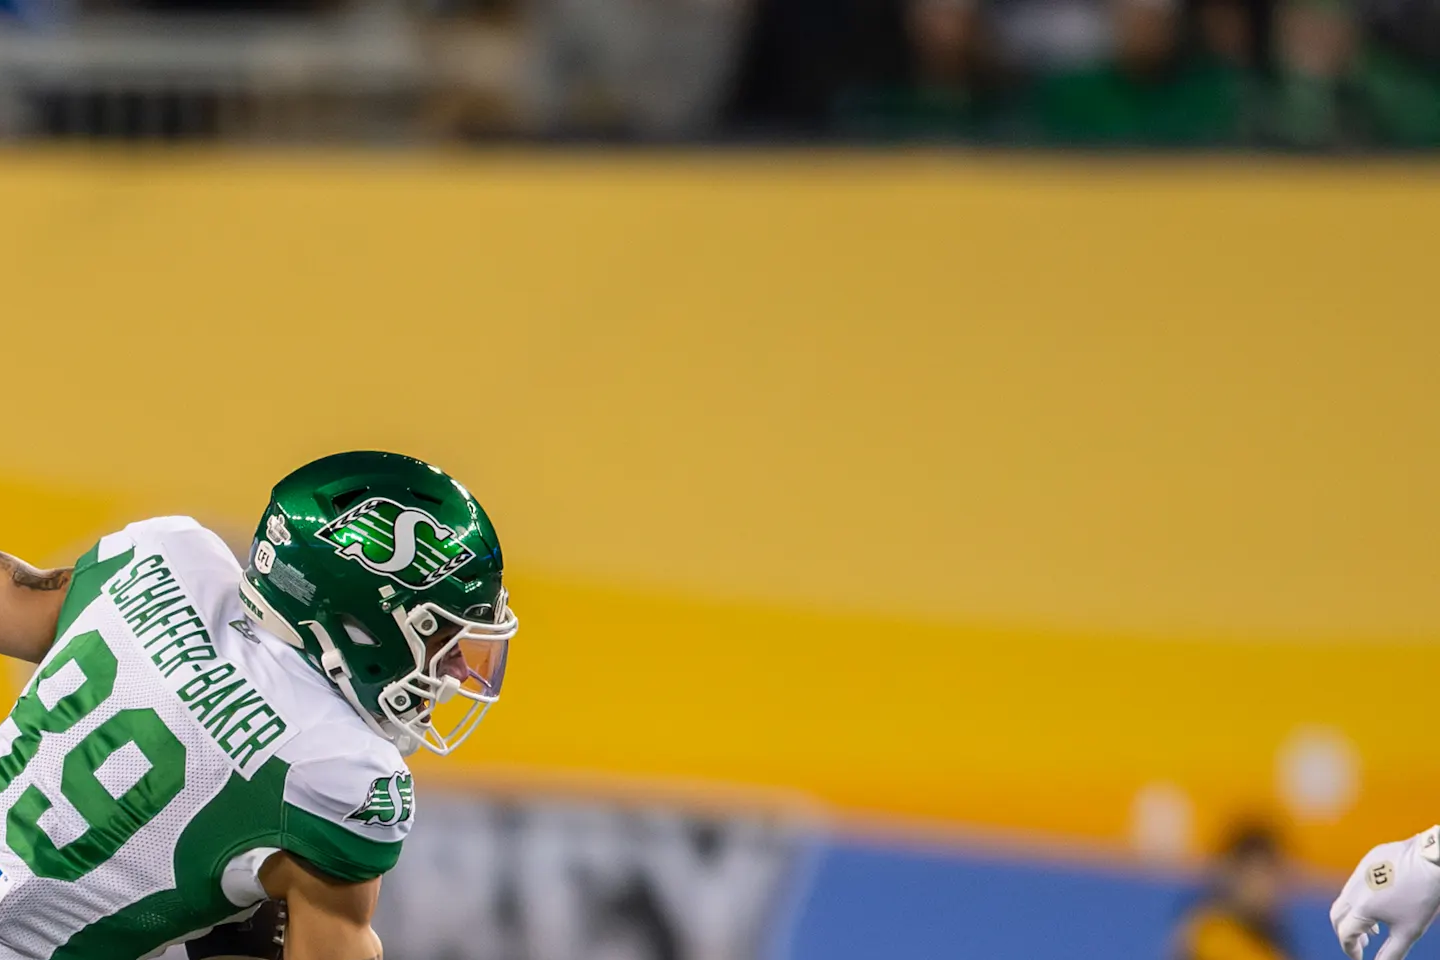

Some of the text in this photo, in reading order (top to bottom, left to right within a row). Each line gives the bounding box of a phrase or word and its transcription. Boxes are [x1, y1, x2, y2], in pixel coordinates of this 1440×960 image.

[257, 549, 269, 567] CFL
[108, 554, 287, 770] SCHAFFER-BAKER
[1372, 864, 1388, 885] CFL
